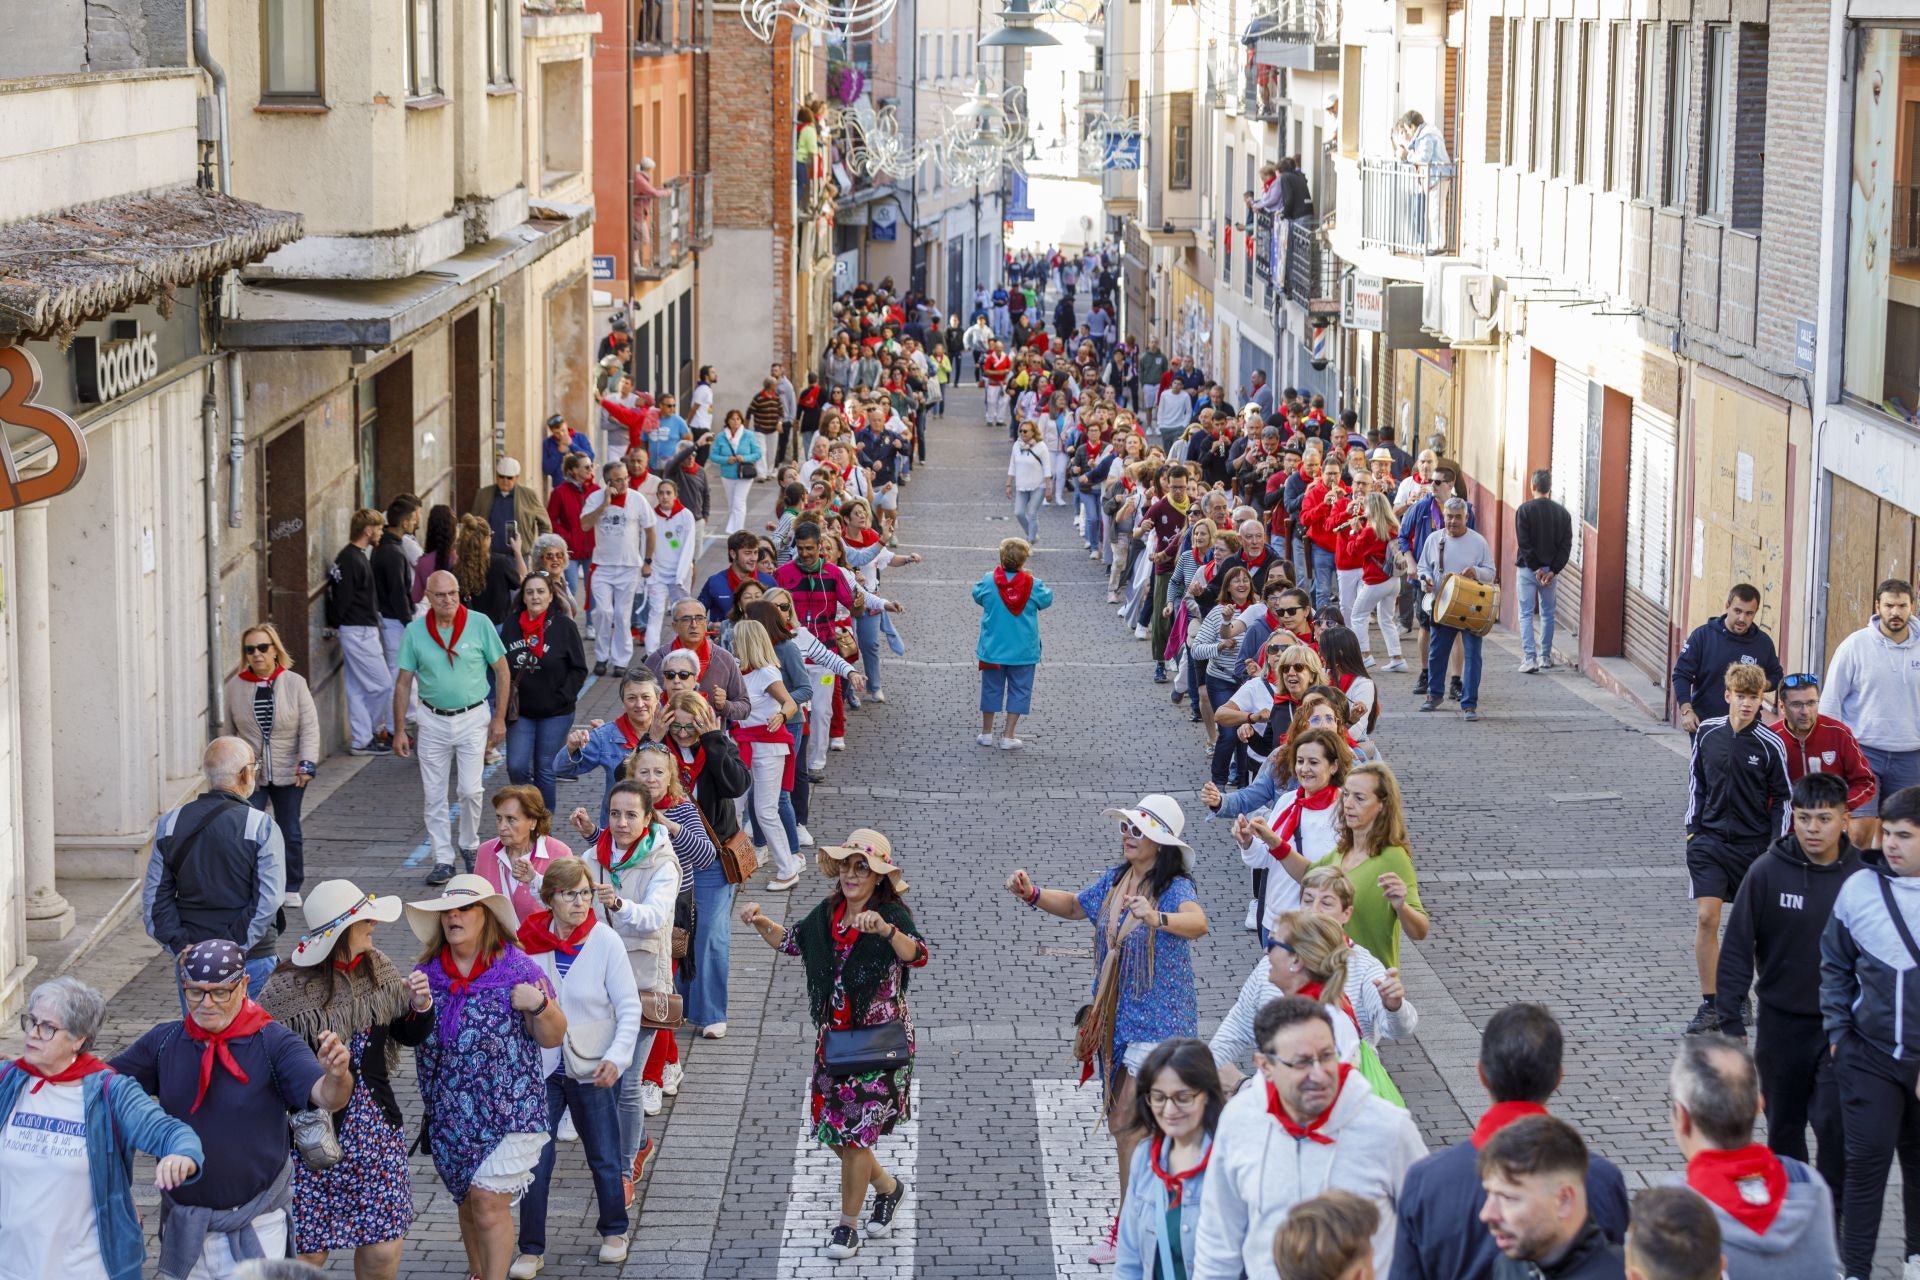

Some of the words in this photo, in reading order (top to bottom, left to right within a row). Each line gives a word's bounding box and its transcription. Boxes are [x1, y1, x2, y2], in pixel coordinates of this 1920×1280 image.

[1358, 278, 1380, 288] PUERTAS
[1357, 292, 1380, 312] TEYSAN
[1800, 328, 1812, 343] CALLE
[95, 319, 158, 403] bocados
[1780, 892, 1804, 910] LTN
